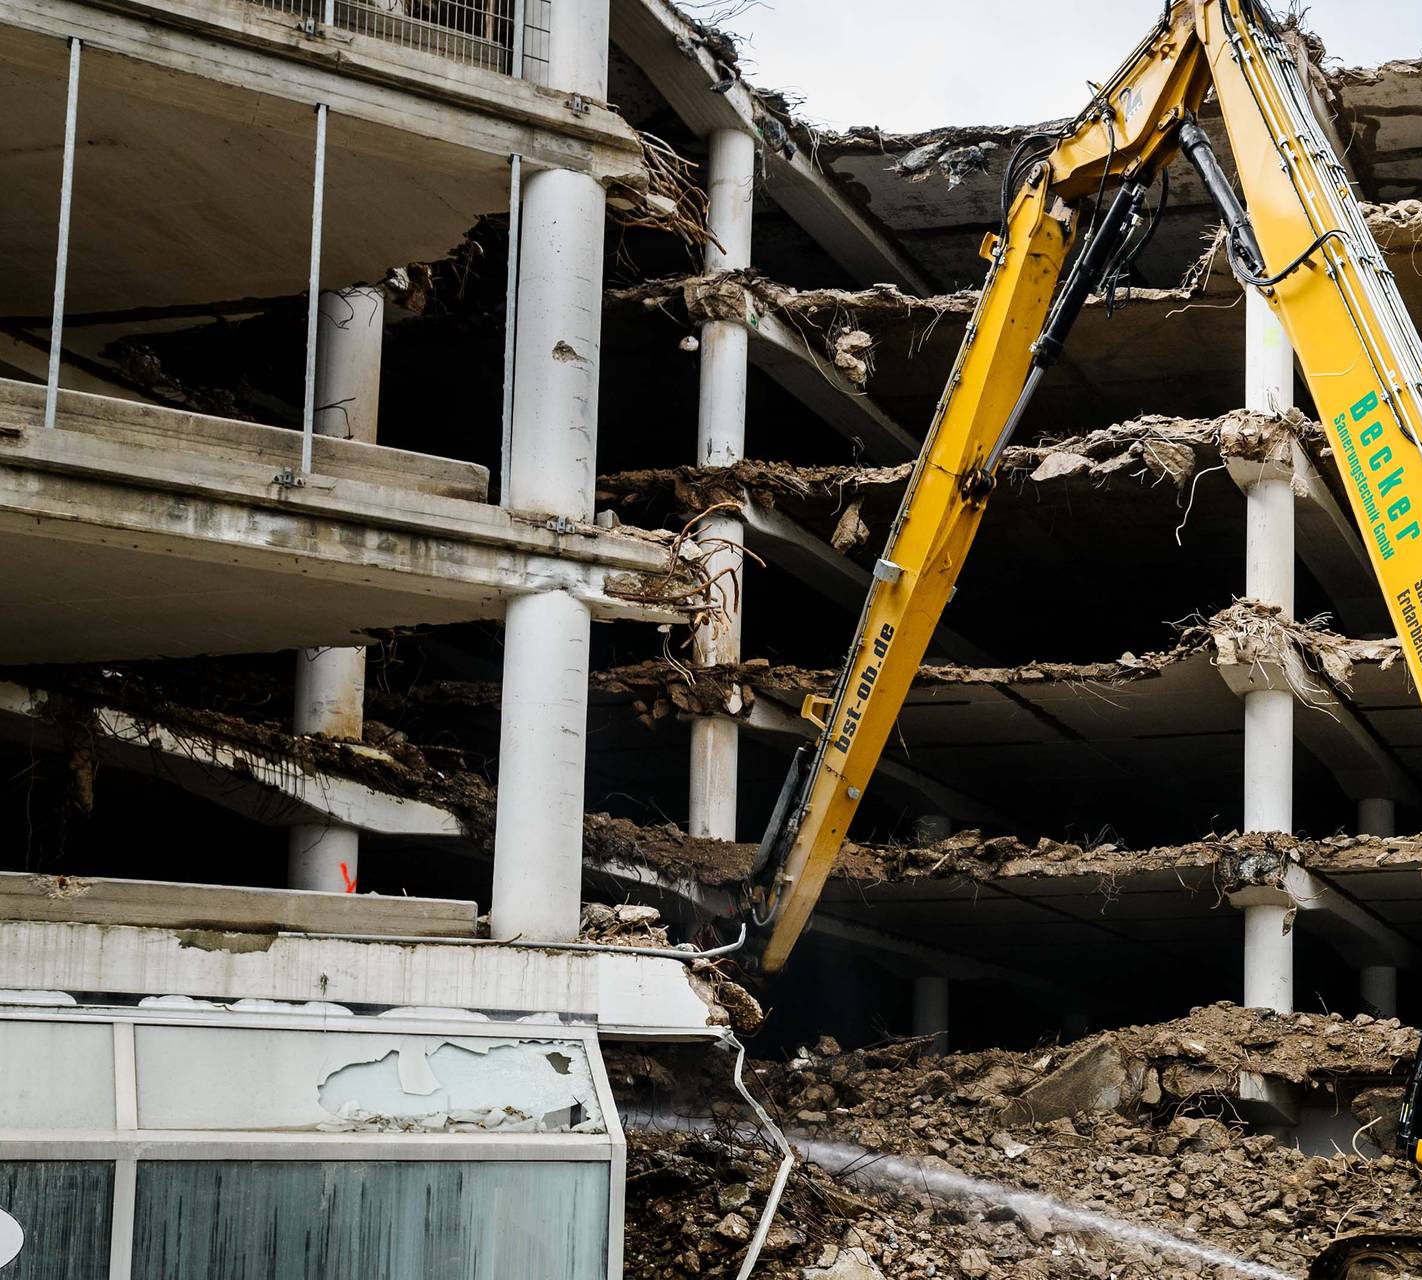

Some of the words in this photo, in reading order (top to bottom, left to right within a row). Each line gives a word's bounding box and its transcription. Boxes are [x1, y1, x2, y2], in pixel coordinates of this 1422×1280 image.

[1333, 412, 1384, 524] Sanierungstechnik
[1373, 521, 1396, 561] GmbH
[1350, 390, 1421, 541] Becker
[833, 622, 895, 754] bst-ob.de
